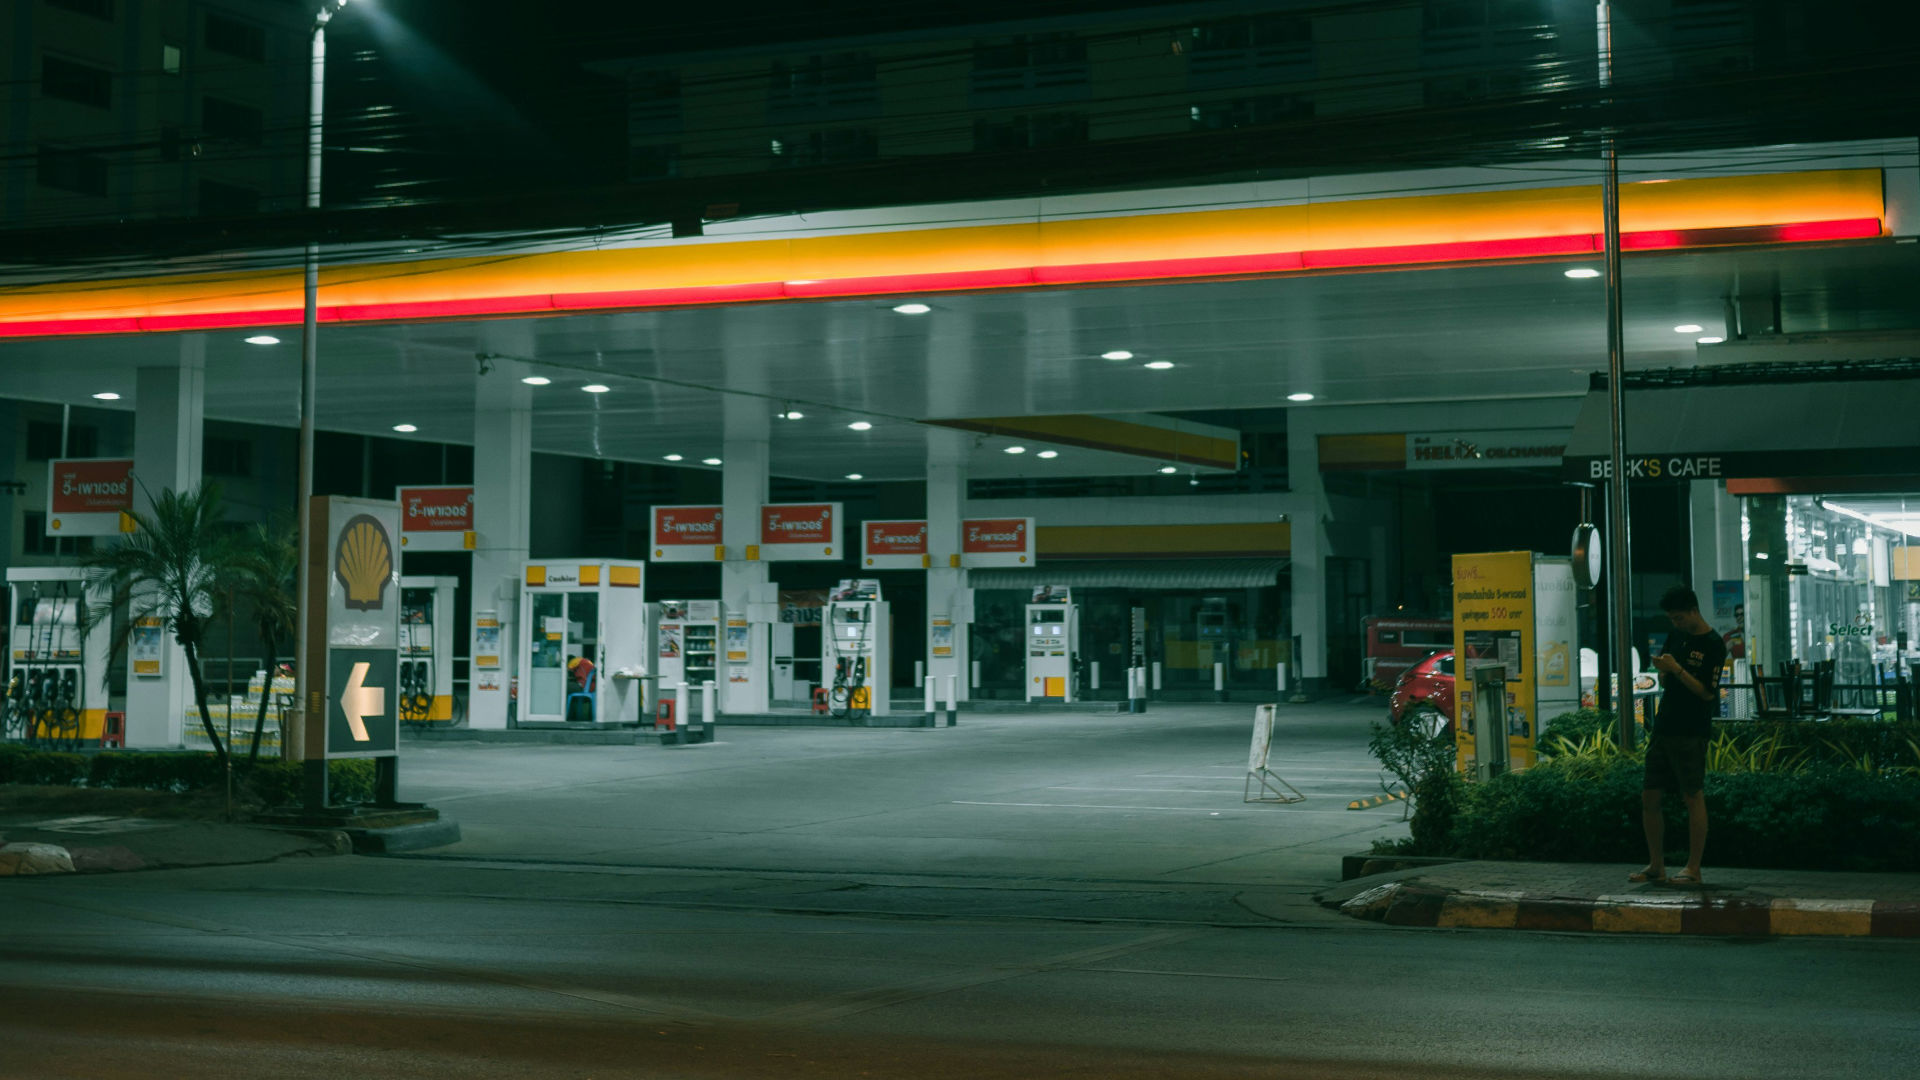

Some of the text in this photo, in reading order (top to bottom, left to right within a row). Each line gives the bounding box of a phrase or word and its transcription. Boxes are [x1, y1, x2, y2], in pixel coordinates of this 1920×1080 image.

[1415, 441, 1480, 460] HELIX
[1668, 458, 1721, 476] CAFE
[1491, 607, 1507, 619] 500
[1829, 623, 1873, 636] Select
